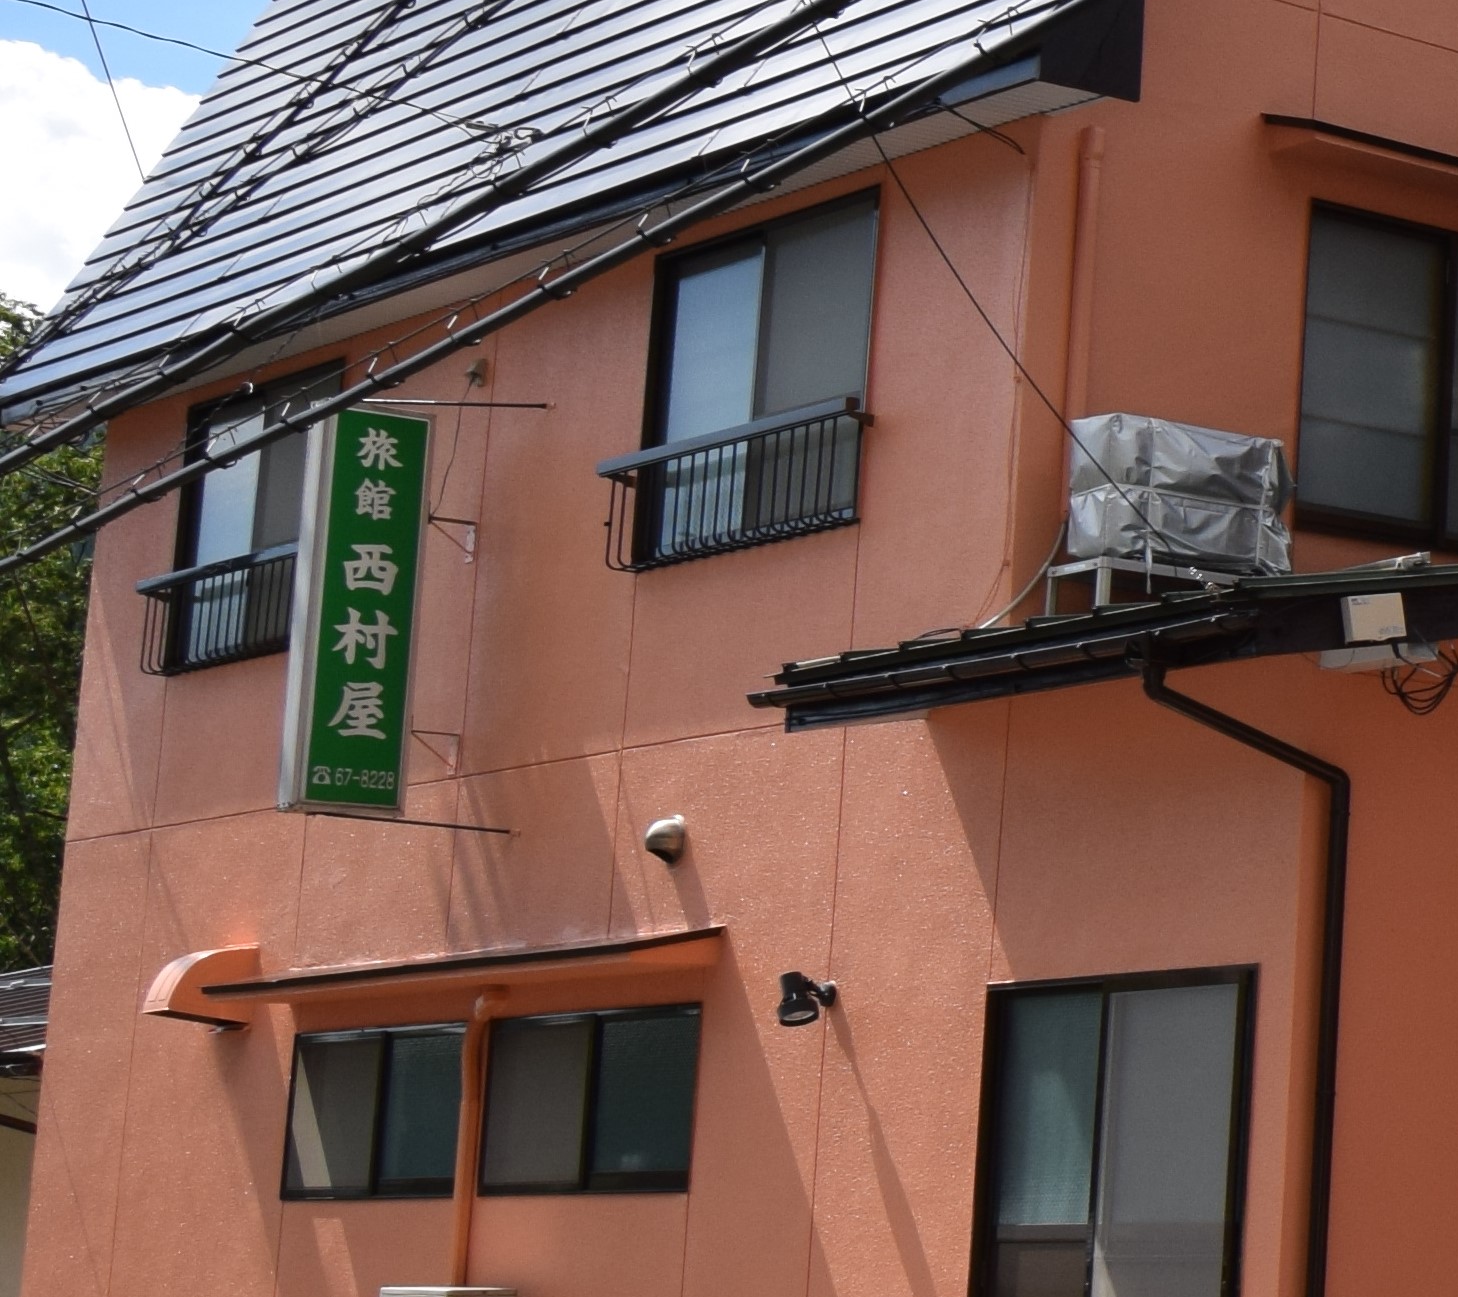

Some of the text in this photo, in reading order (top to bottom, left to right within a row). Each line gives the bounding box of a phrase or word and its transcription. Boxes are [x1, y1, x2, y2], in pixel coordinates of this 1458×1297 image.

[328, 427, 403, 740] 旅館 西村屋
[334, 767, 395, 790] 67-8228
